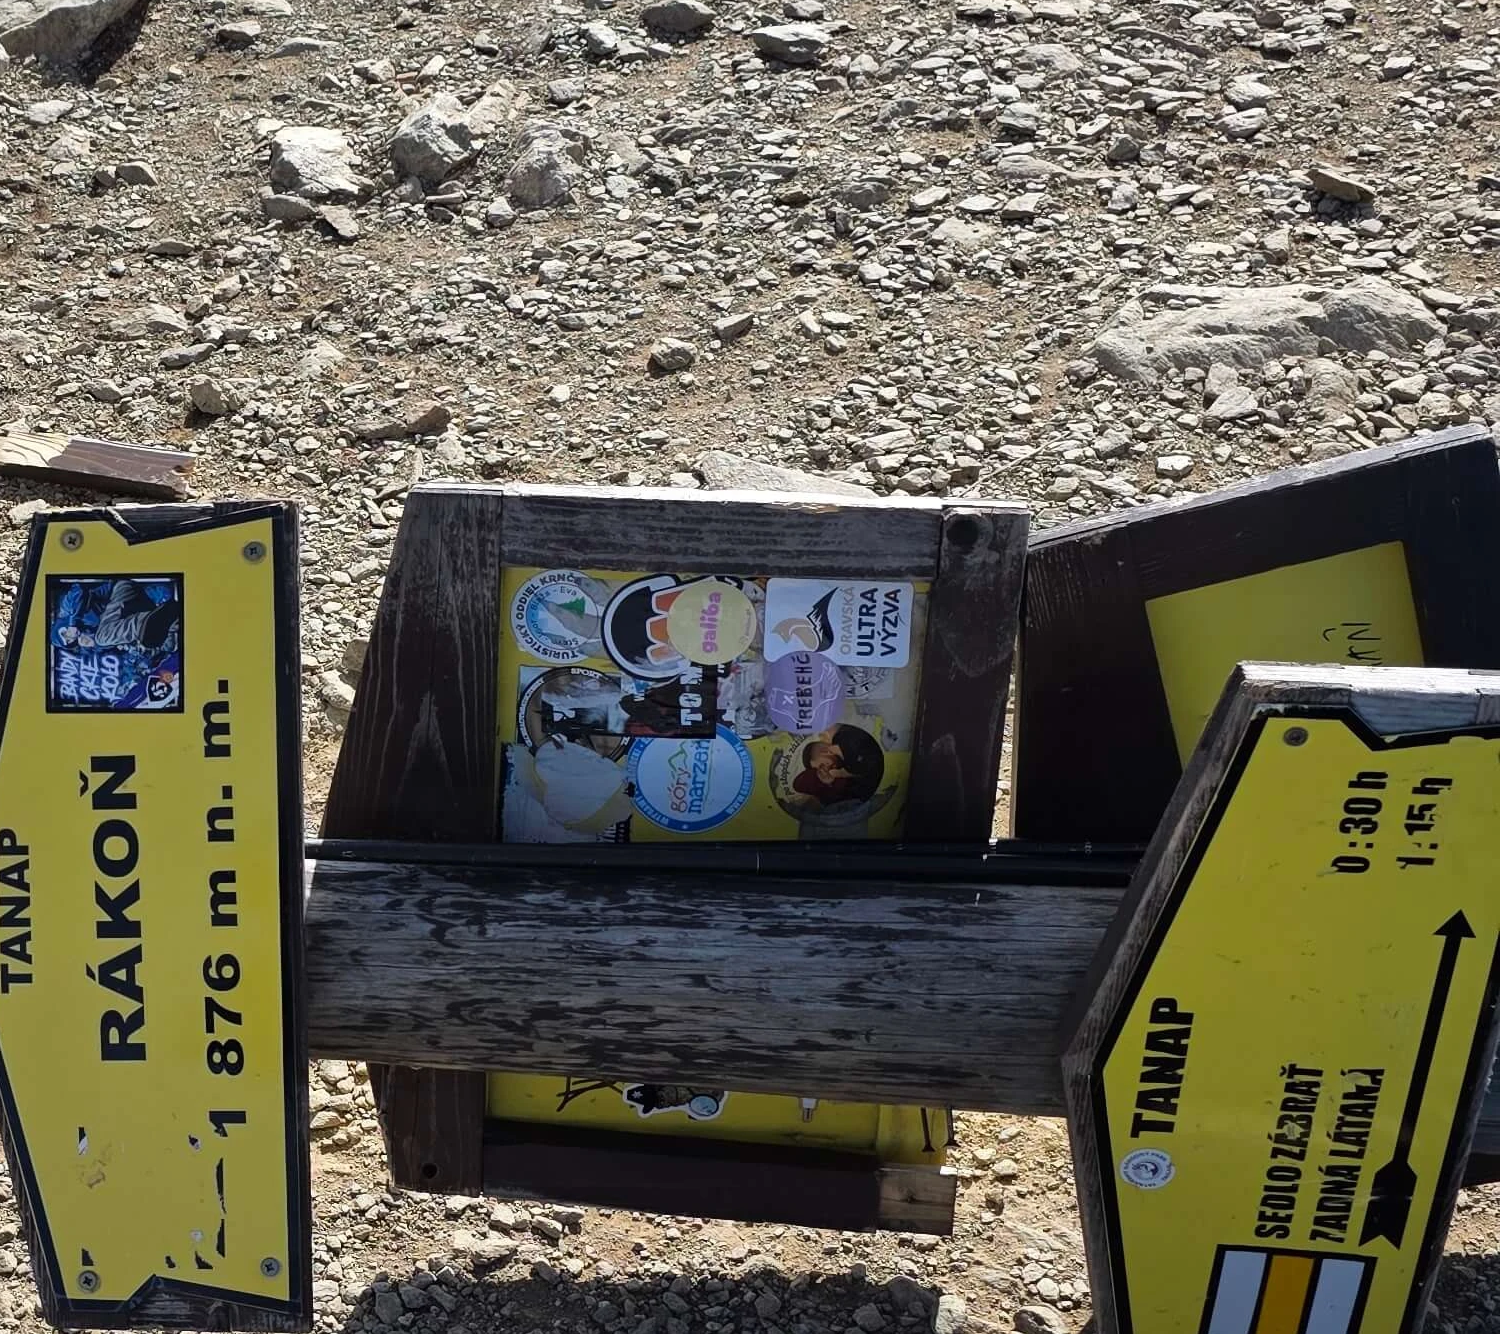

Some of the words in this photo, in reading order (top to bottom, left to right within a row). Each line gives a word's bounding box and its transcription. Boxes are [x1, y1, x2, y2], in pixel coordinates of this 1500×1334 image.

[515, 584, 540, 620] ODDIEL
[699, 591, 722, 654] galiba
[836, 586, 856, 655] ORAVSKÁ
[856, 588, 878, 656] ULTRA
[877, 589, 902, 656] VÝZVA
[55, 650, 81, 702] BANDY
[200, 677, 231, 758] m.
[205, 784, 235, 842] n.
[668, 766, 692, 813] góry
[1347, 771, 1388, 789] h
[78, 753, 147, 1062] RÁKOŇ
[207, 870, 239, 928] m
[201, 953, 245, 1078] 876
[1129, 996, 1195, 1139] TANAP
[1267, 1063, 1324, 1162] ZÁBRAŤ
[1254, 1165, 1302, 1239] SEDLO
[1309, 1164, 1361, 1244] ZADNÁ
